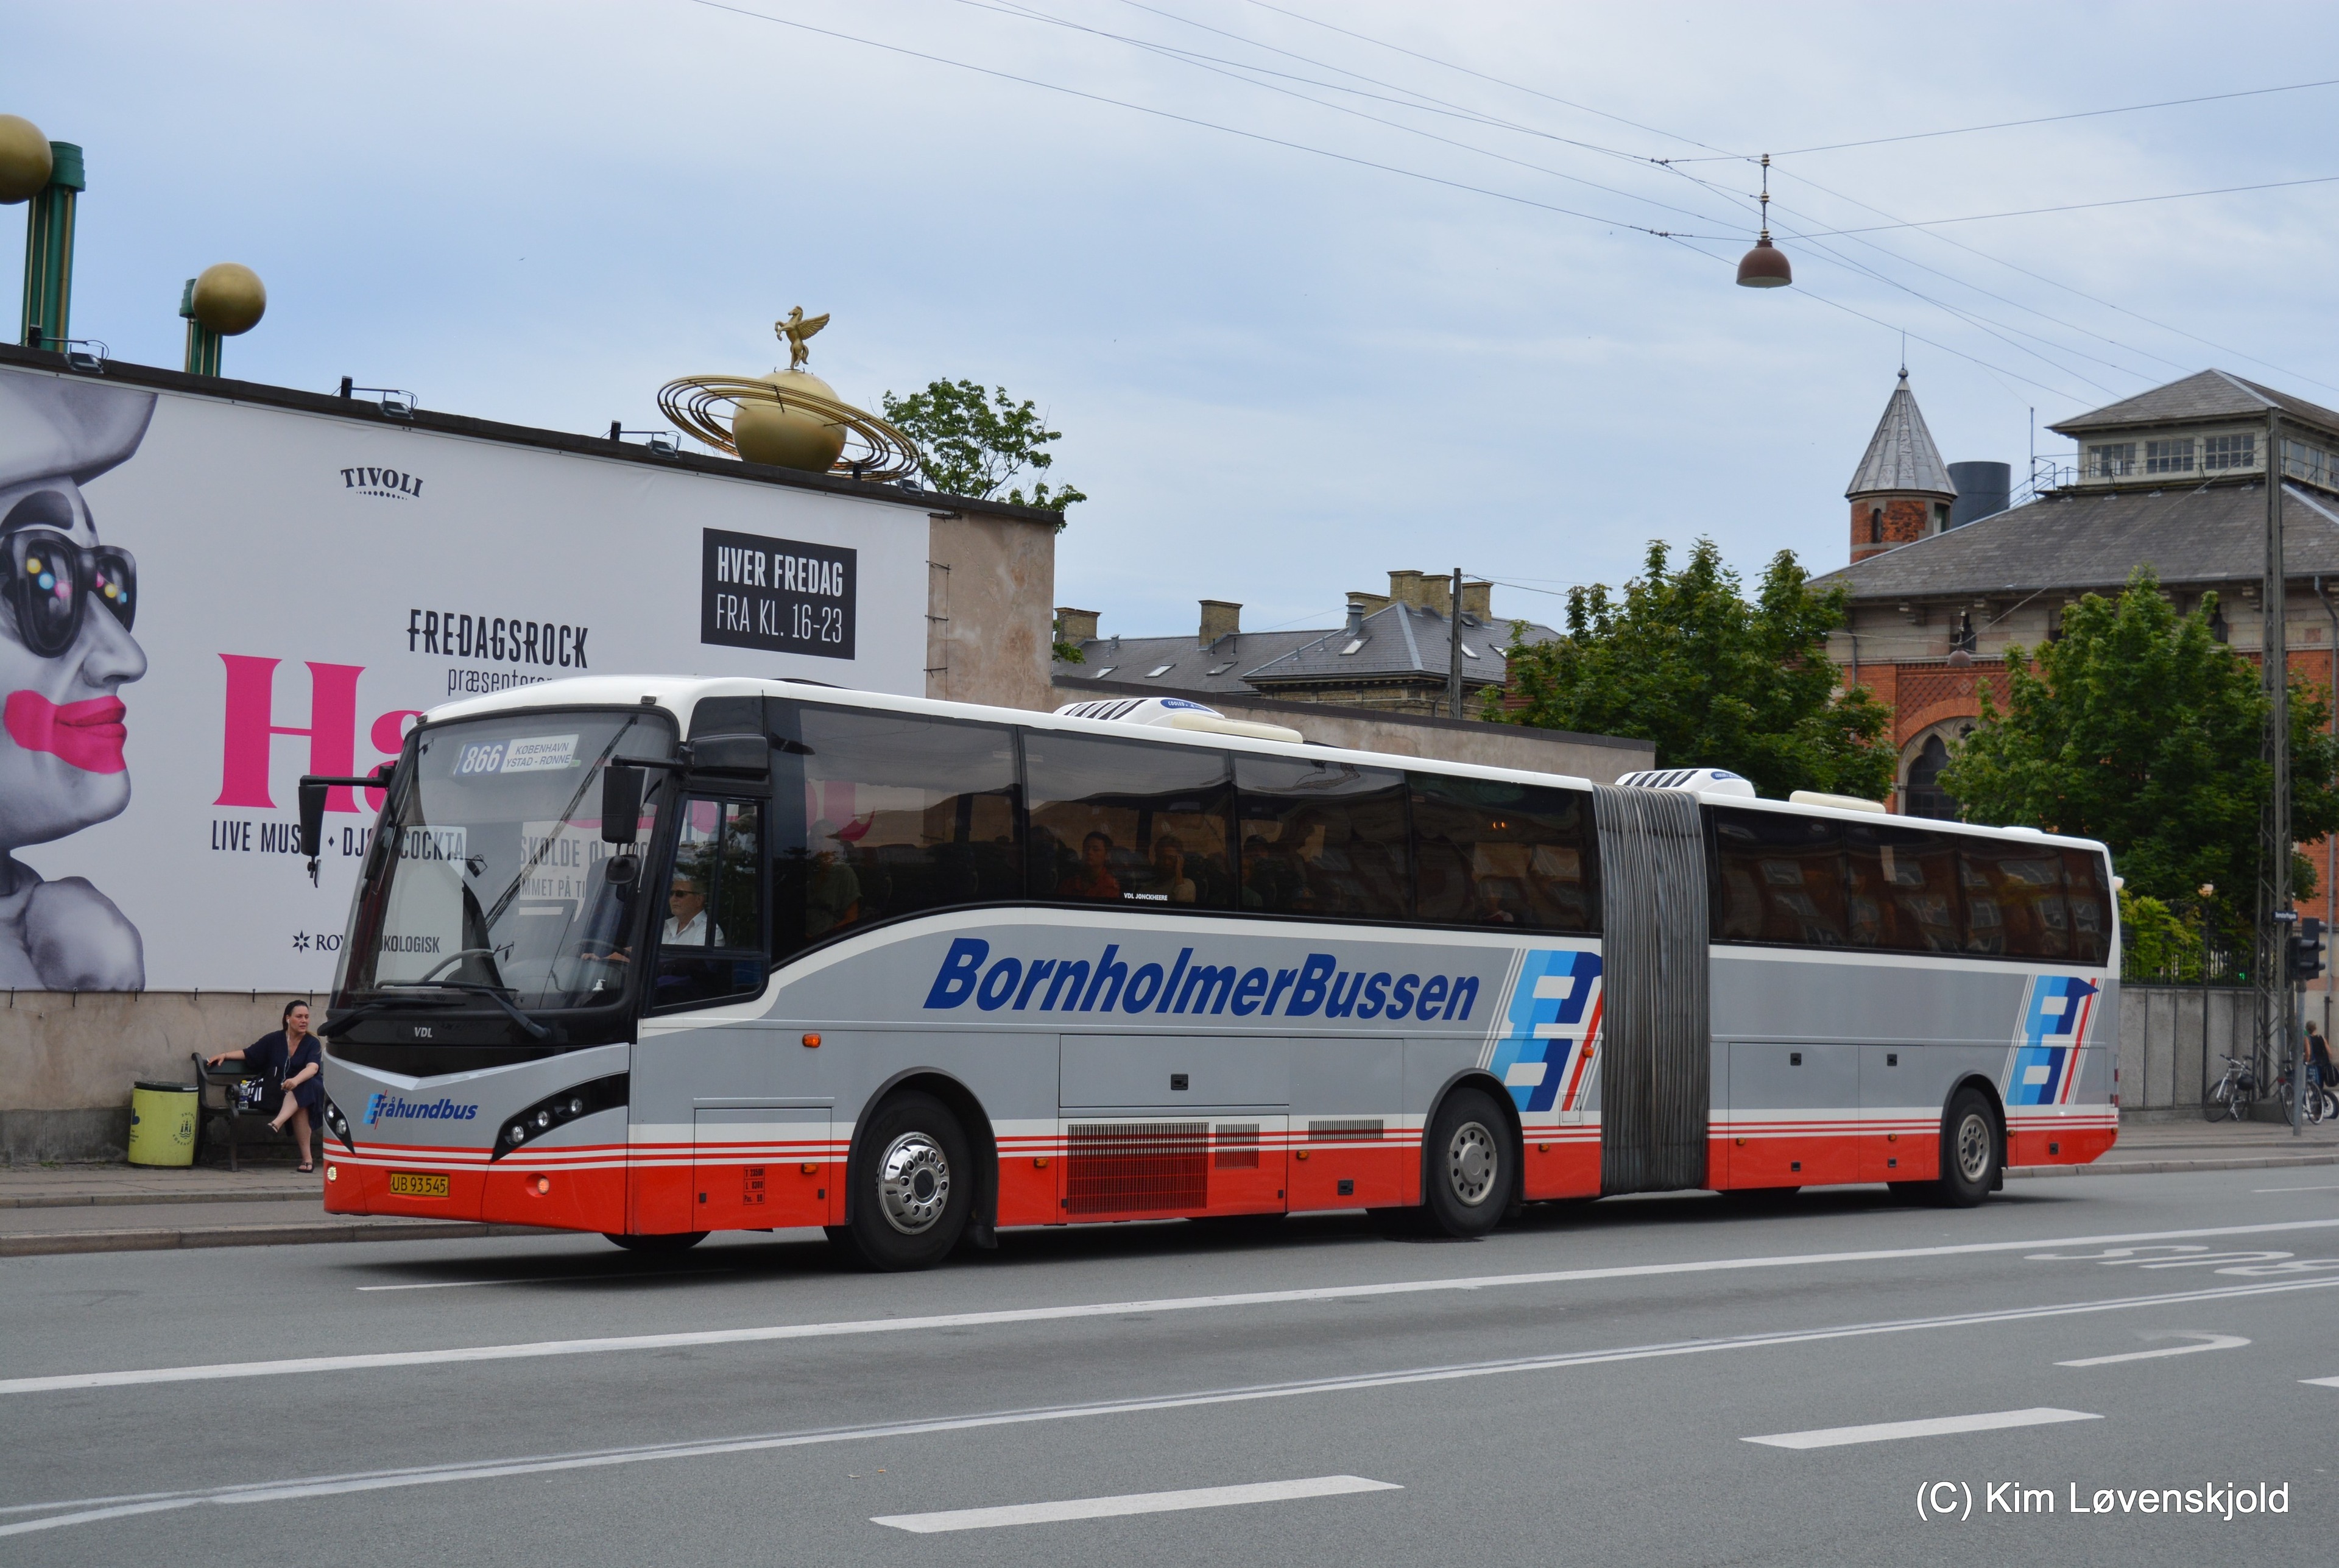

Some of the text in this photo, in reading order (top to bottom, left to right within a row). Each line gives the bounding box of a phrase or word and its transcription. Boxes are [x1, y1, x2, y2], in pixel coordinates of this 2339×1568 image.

[340, 467, 423, 498] TIVOLI
[718, 546, 843, 597] HVER FREDAG
[717, 593, 842, 643] FRA KL. 16-23
[406, 609, 588, 669] FREDAGSROCK
[462, 744, 503, 774] 866
[506, 758, 532, 768] YSTAD
[540, 754, 571, 765] RØNNE
[515, 743, 569, 755] KØBENHAVN
[212, 820, 251, 852] LIVE
[261, 823, 302, 854] MUS
[559, 875, 571, 897] PÅ
[923, 938, 1480, 1022] BornholmerBussen
[414, 1027, 432, 1037] VDL
